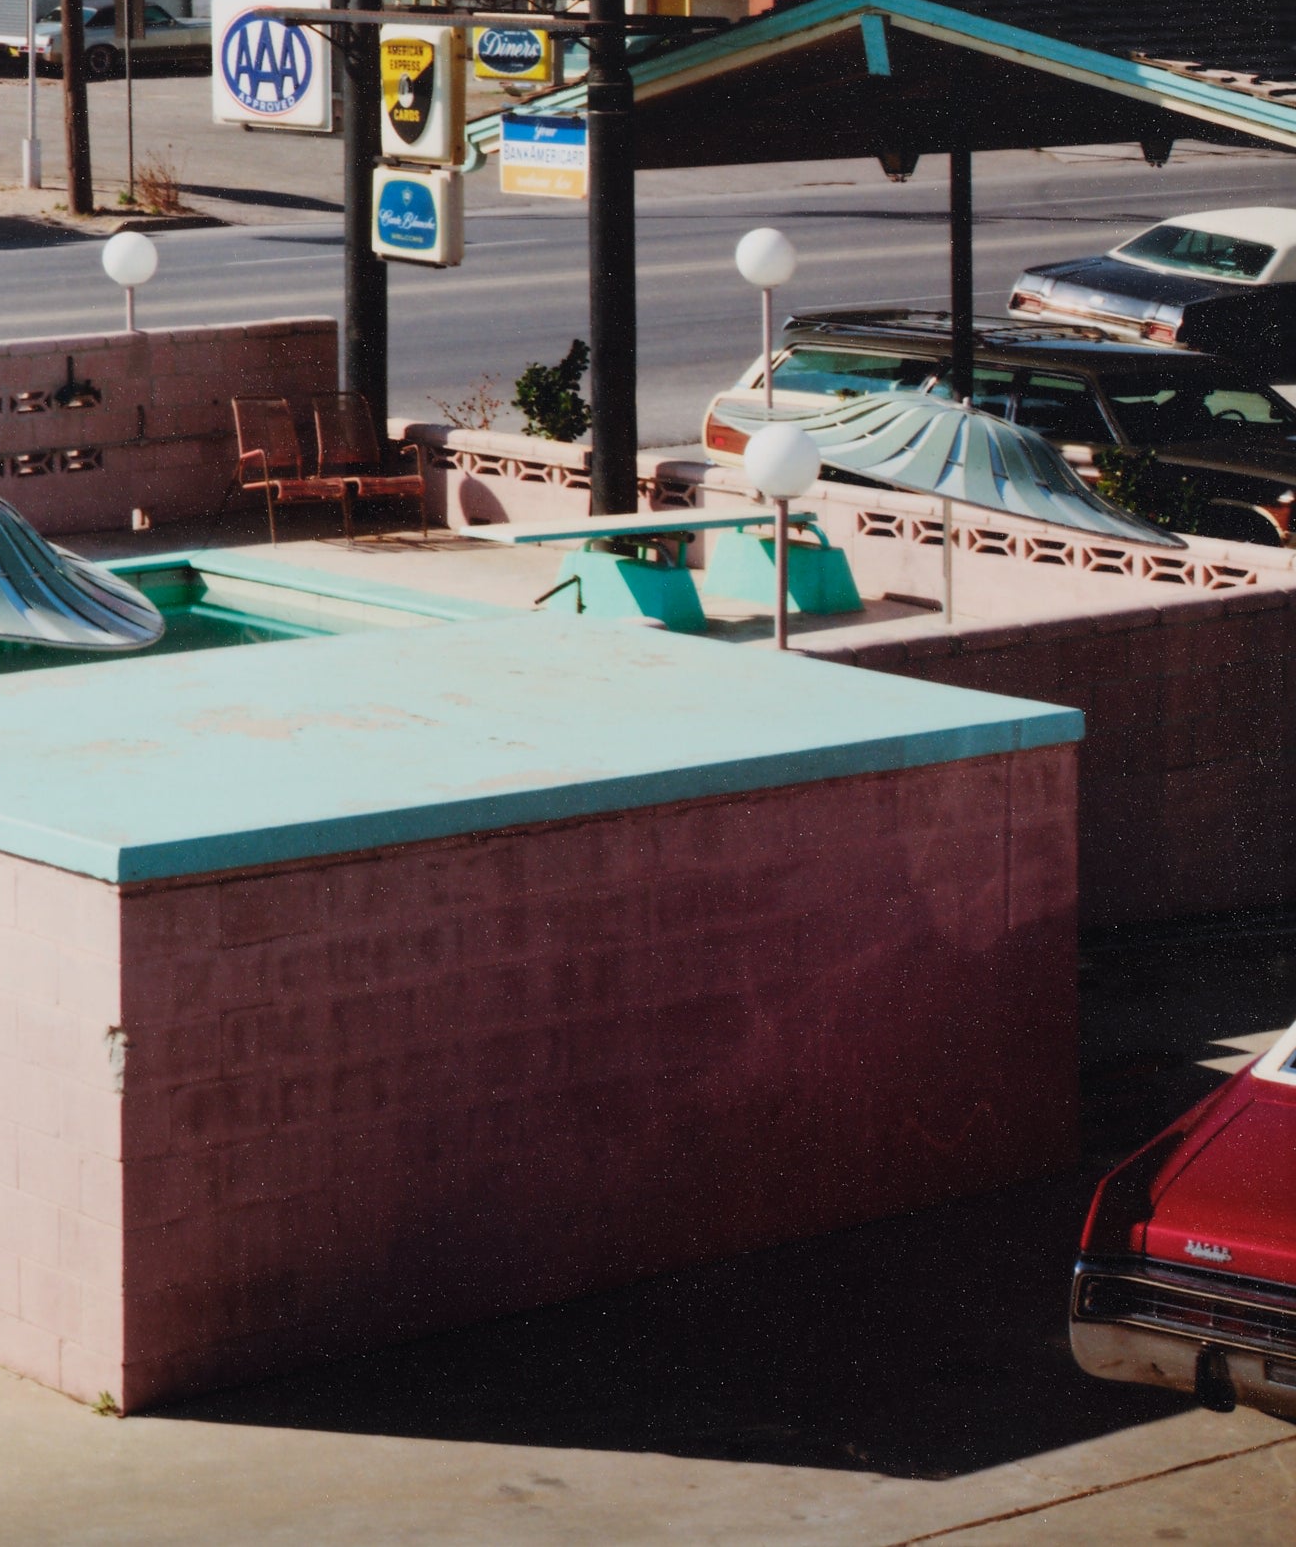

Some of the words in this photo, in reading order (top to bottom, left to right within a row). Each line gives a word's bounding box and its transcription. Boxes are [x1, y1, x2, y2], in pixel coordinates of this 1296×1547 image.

[388, 45, 424, 56] AMERICAN
[481, 30, 540, 59] Diners
[235, 21, 300, 100] AAA
[390, 59, 421, 71] EXPRESS
[238, 93, 296, 112] APPROVED
[394, 109, 421, 122] CARDS
